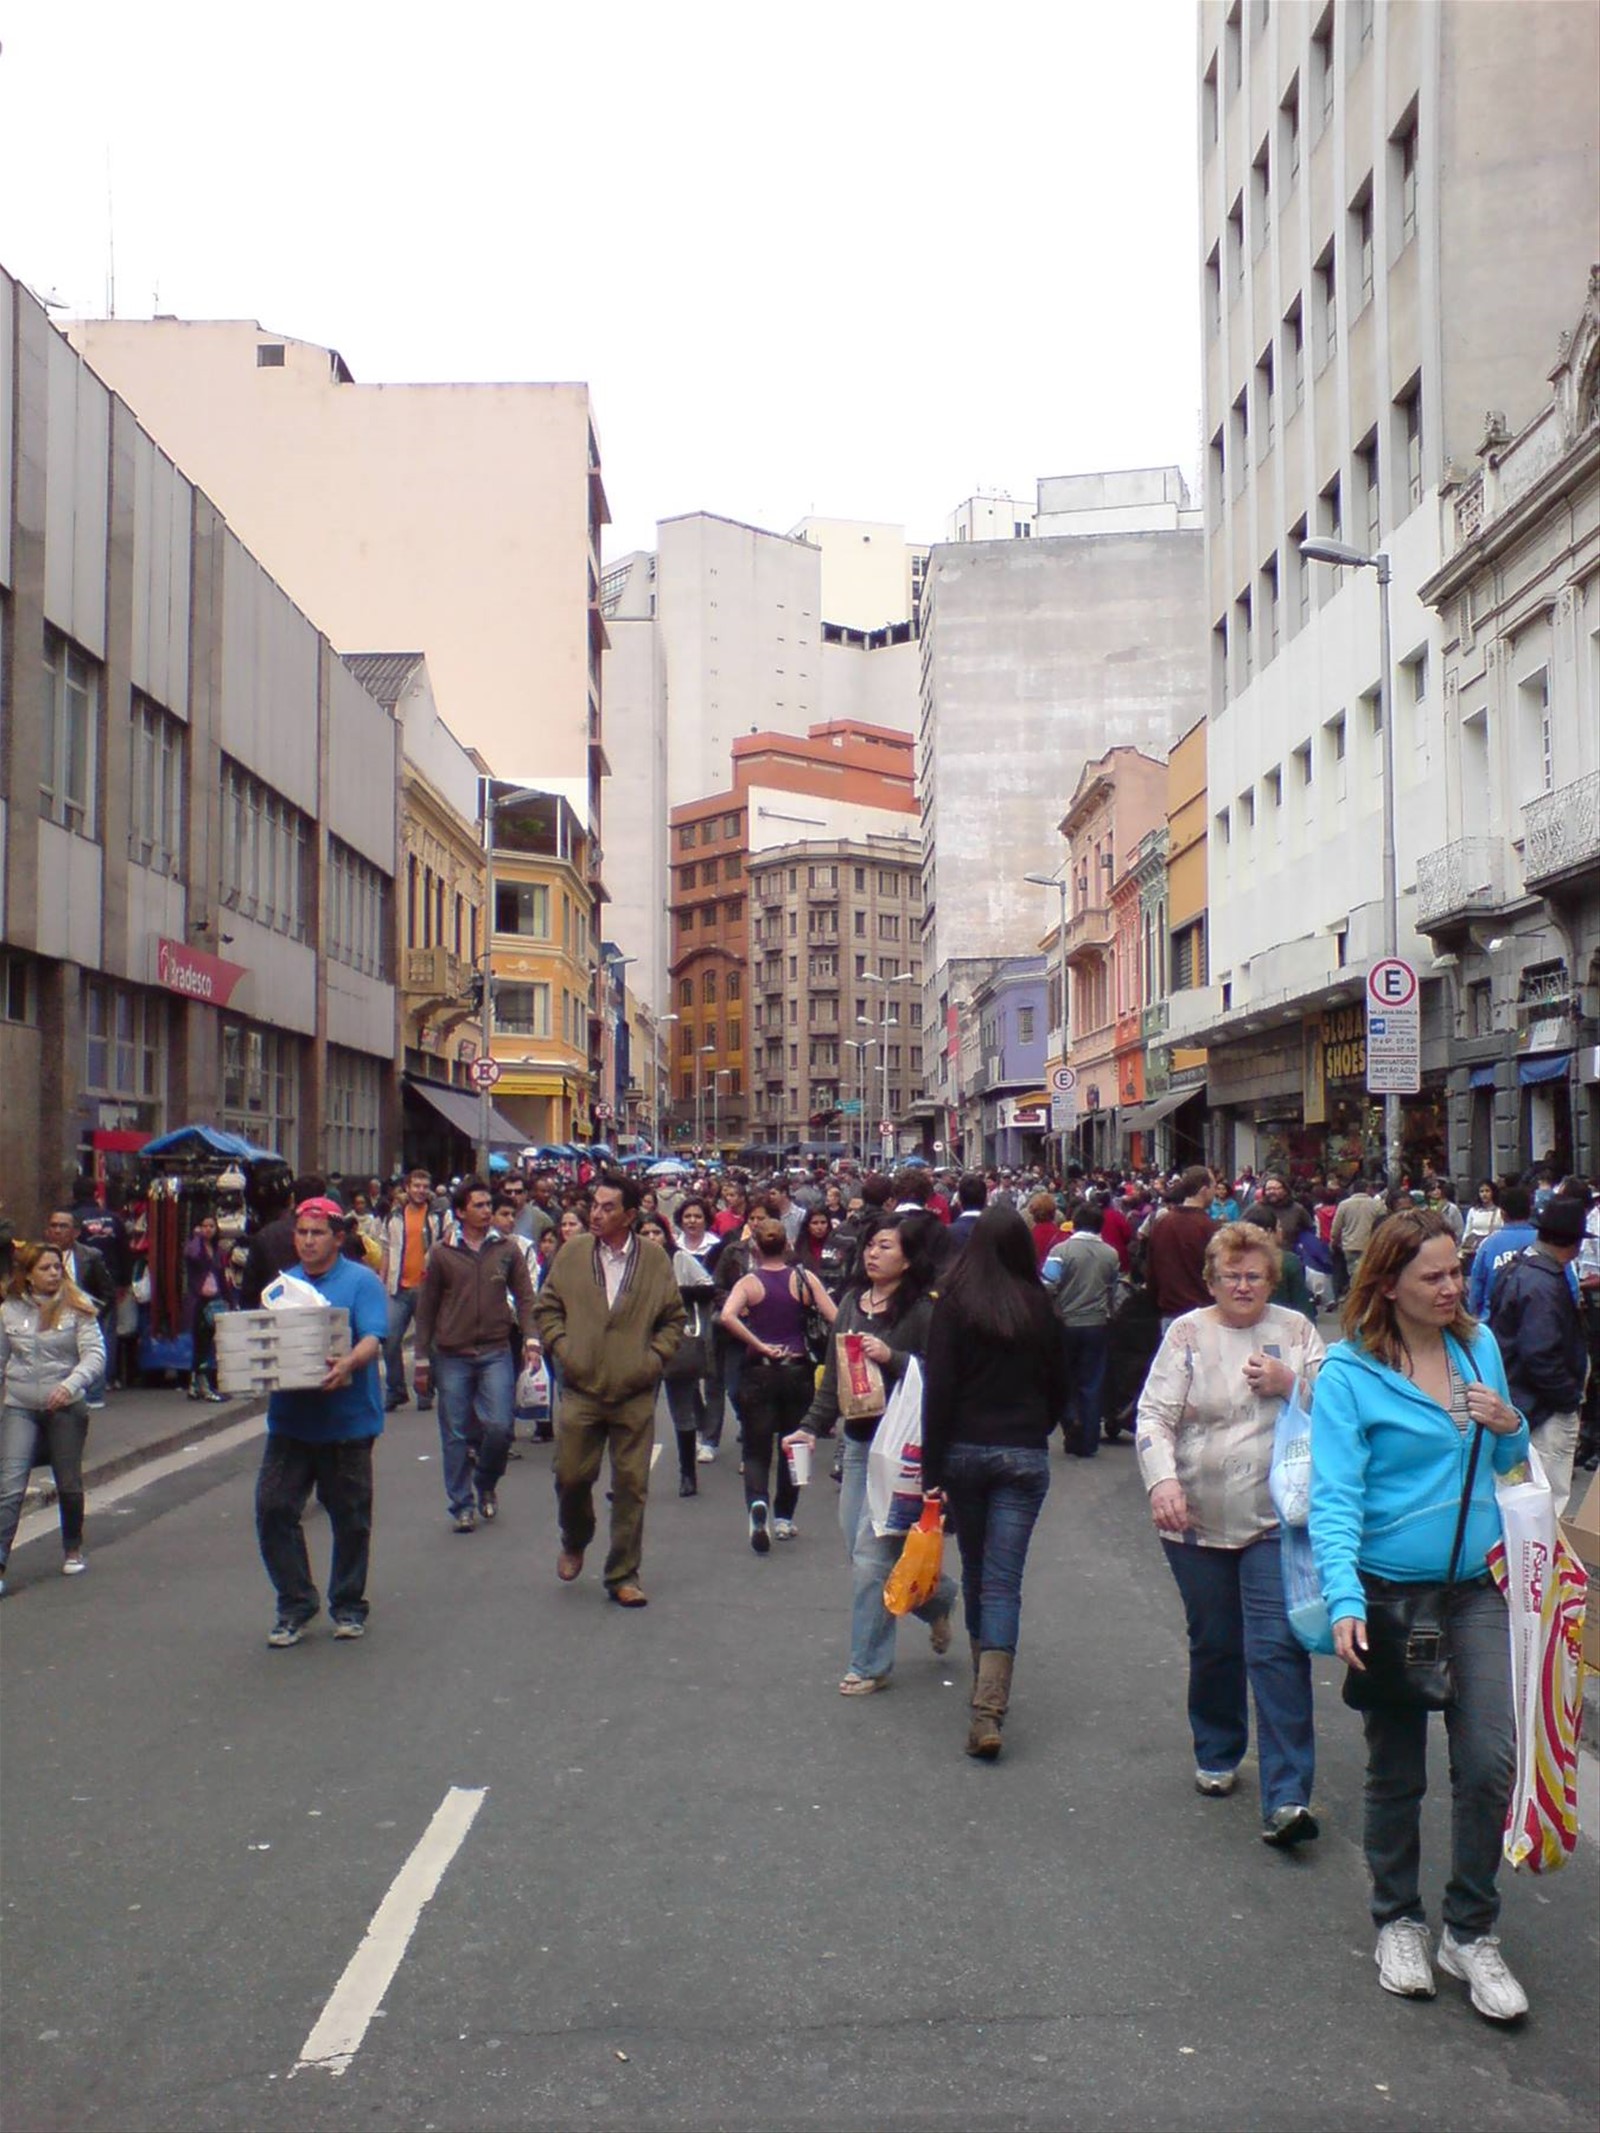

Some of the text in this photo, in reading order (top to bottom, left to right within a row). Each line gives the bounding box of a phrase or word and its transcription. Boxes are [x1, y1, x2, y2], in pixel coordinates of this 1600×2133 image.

[170, 958, 212, 998] Bradesco
[1385, 970, 1401, 995] E
[1321, 1007, 1365, 1043] GLOBA
[1326, 1040, 1366, 1079] SHOES
[1060, 1073, 1068, 1085] E
